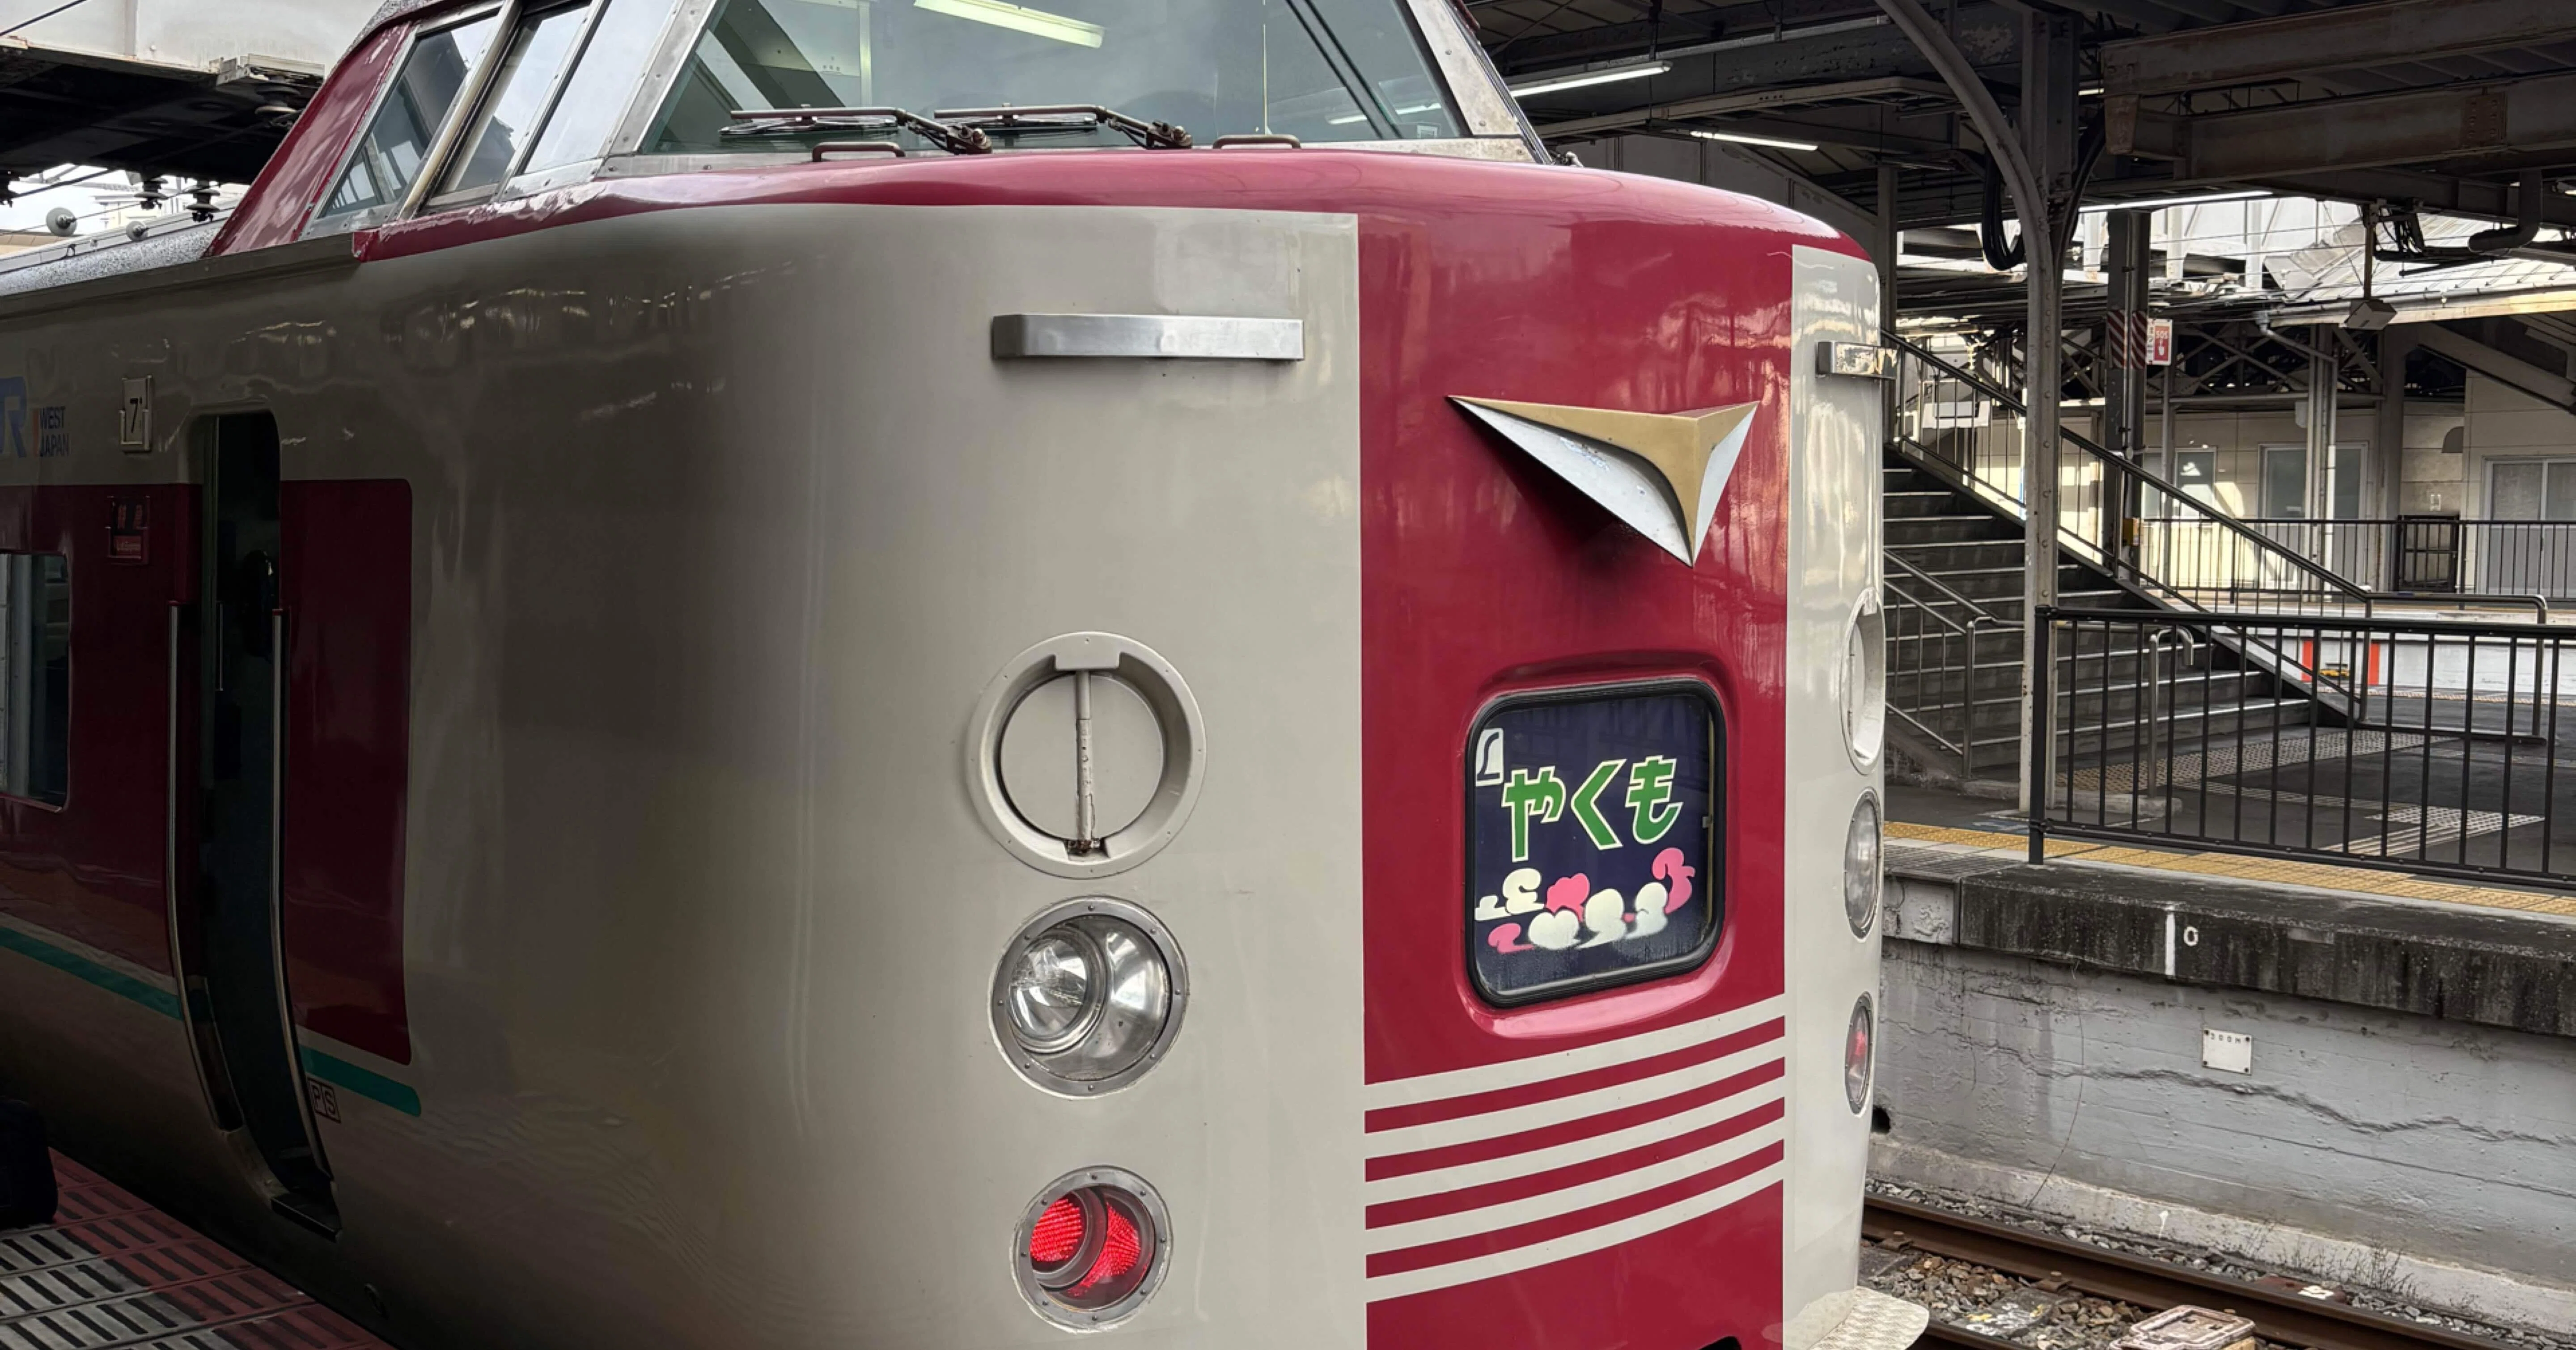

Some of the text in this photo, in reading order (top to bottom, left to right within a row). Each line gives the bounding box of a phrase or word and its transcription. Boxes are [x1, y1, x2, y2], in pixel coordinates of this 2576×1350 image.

[0, 376, 26, 458] R
[38, 405, 64, 428] WEST
[38, 432, 69, 457] JAPAN
[1501, 755, 1684, 863] やくも
[310, 1084, 336, 1115] PS
